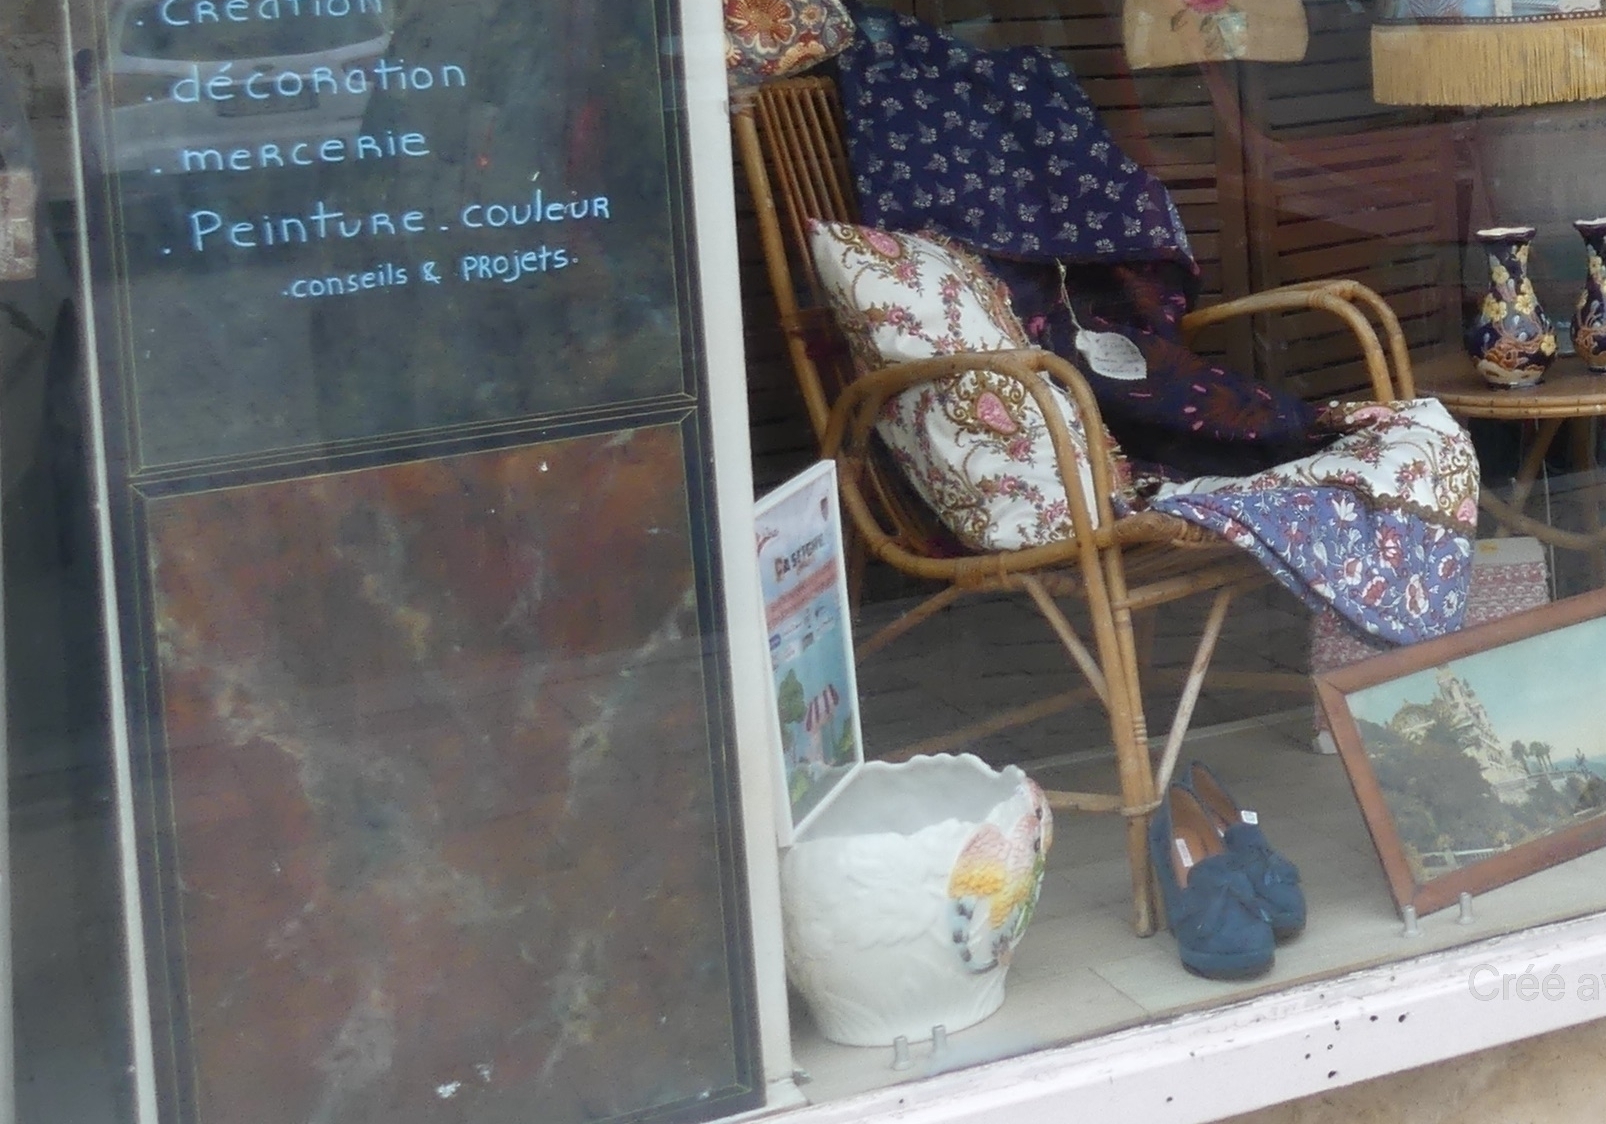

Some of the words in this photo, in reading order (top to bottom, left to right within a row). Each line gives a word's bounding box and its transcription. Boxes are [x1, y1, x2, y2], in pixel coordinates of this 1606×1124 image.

[171, 59, 467, 104] décoration
[182, 130, 431, 171] mercerie
[190, 200, 426, 252] Peinture
[461, 188, 610, 228] couleur
[420, 261, 443, 285] &
